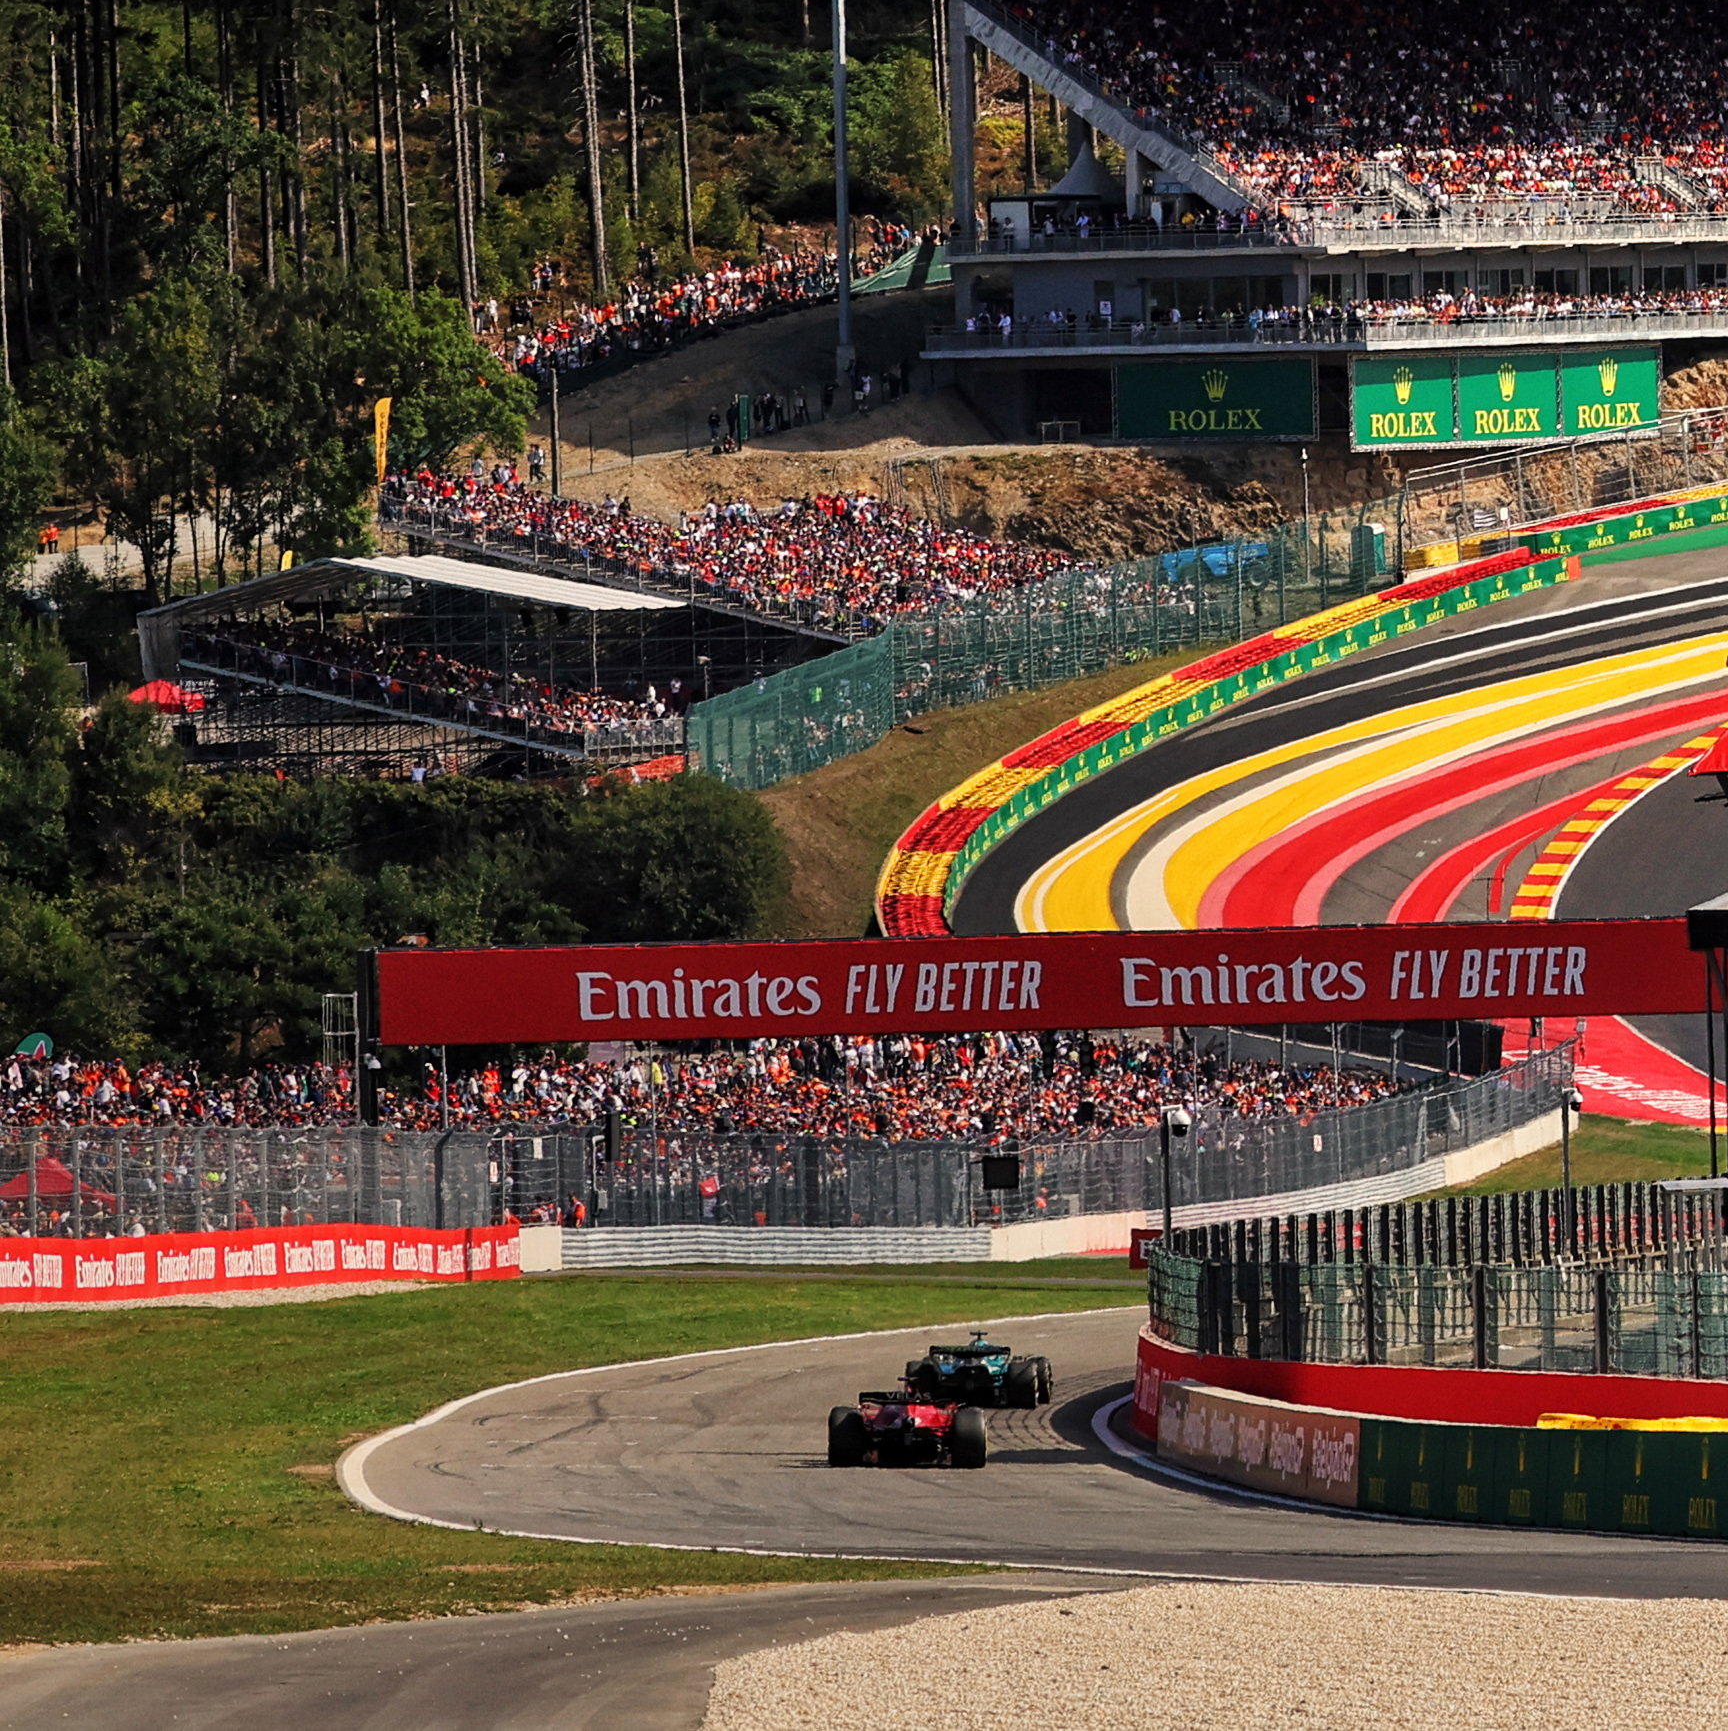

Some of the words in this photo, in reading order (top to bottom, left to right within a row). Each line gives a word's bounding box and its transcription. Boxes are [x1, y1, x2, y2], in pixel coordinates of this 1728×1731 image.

[1167, 408, 1262, 431] ROLEX
[1370, 411, 1438, 438] ROLEX
[1474, 408, 1542, 435] ROLEX
[1577, 402, 1641, 429] ROLEX
[1669, 518, 1694, 531] ROLEX
[1588, 534, 1615, 549] ROLEX
[1555, 572, 1569, 583] ROL
[1119, 953, 1367, 1008] Emirates
[1390, 949, 1449, 1001] FLY
[1459, 945, 1586, 1000] BETTER
[576, 968, 821, 1021] Emirates
[846, 963, 904, 1015] FLY
[914, 960, 1042, 1013] BETTER
[75, 1253, 115, 1288] Emirates
[886, 1392, 932, 1400] VELAS
